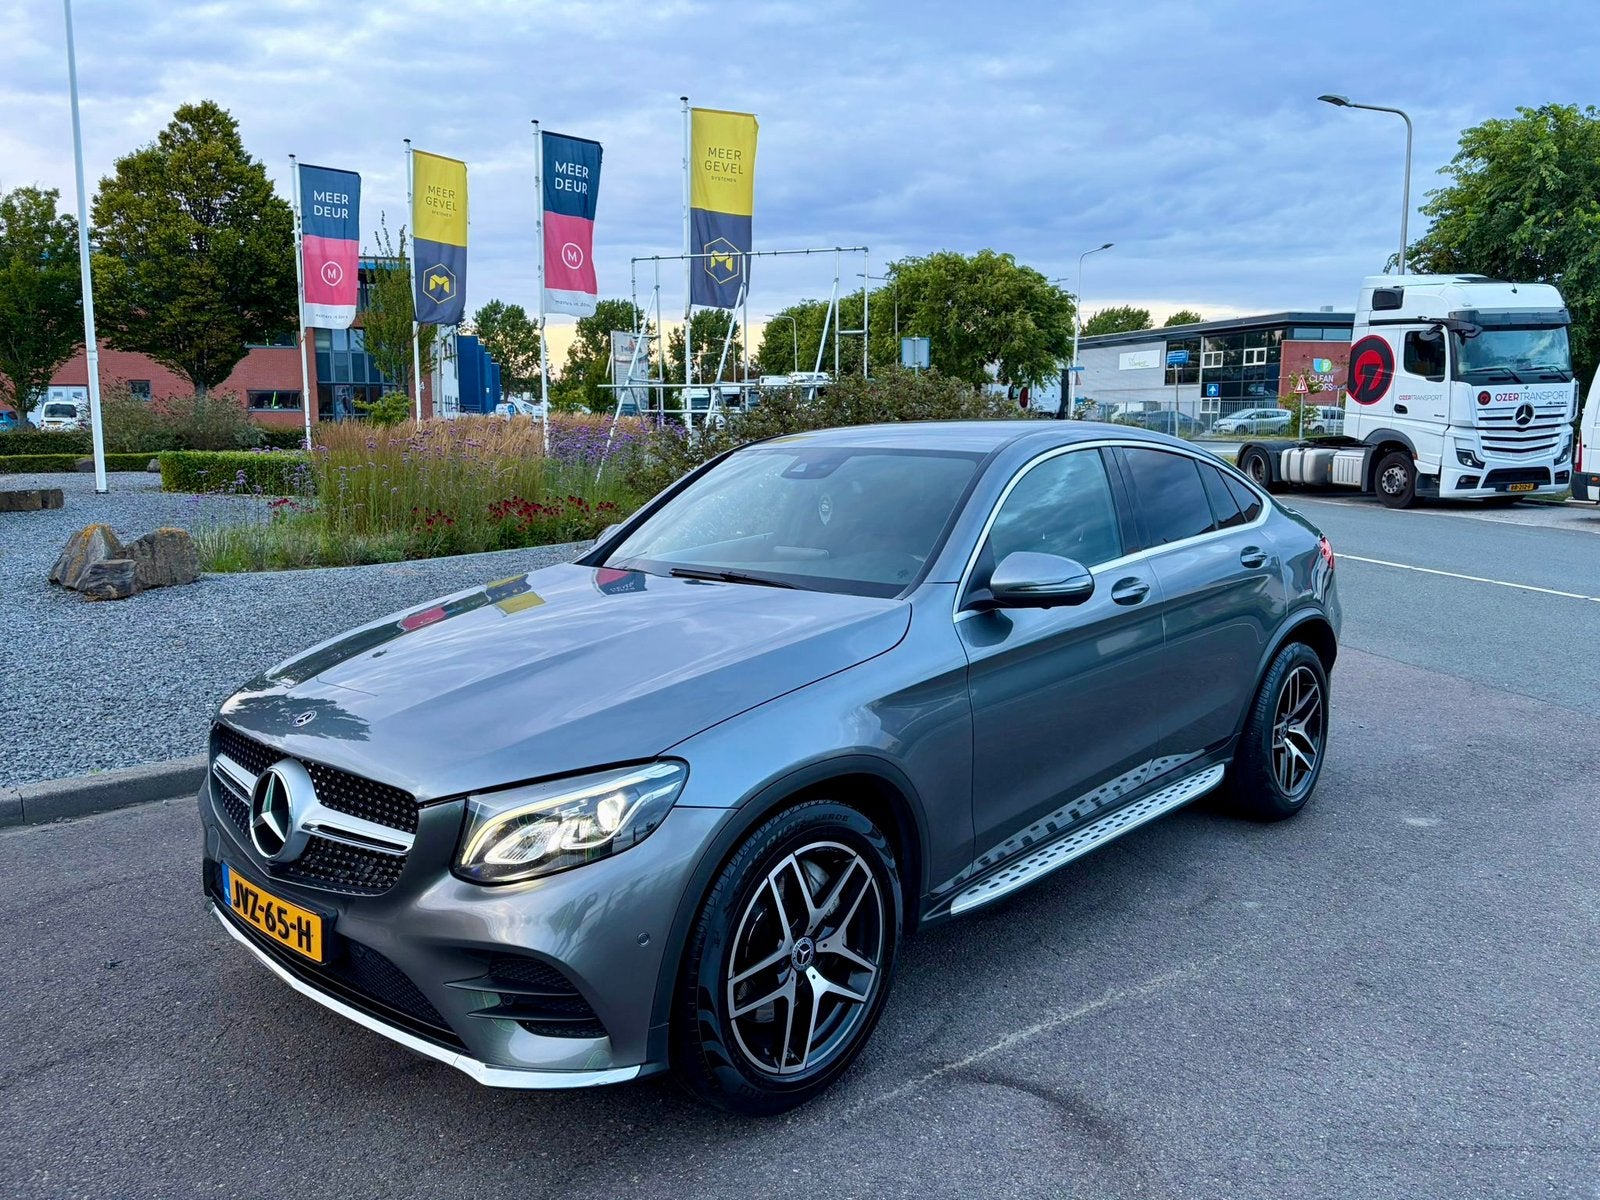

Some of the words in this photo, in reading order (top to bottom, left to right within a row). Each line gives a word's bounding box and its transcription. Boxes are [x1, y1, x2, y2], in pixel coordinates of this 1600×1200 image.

[707, 147, 742, 160] MEER
[555, 161, 589, 179] MEER
[704, 160, 743, 174] GEVEL
[428, 185, 456, 199] MEER
[554, 177, 588, 195] DEUR
[313, 190, 349, 205] MEER
[425, 196, 457, 211] GEVEL
[313, 205, 349, 219] DEUR
[567, 250, 577, 262] M
[327, 268, 336, 279] M
[1309, 375, 1334, 383] CLEAN
[1495, 390, 1568, 402] OZERTRANSPORT
[233, 880, 311, 953] JVZ-65-H
